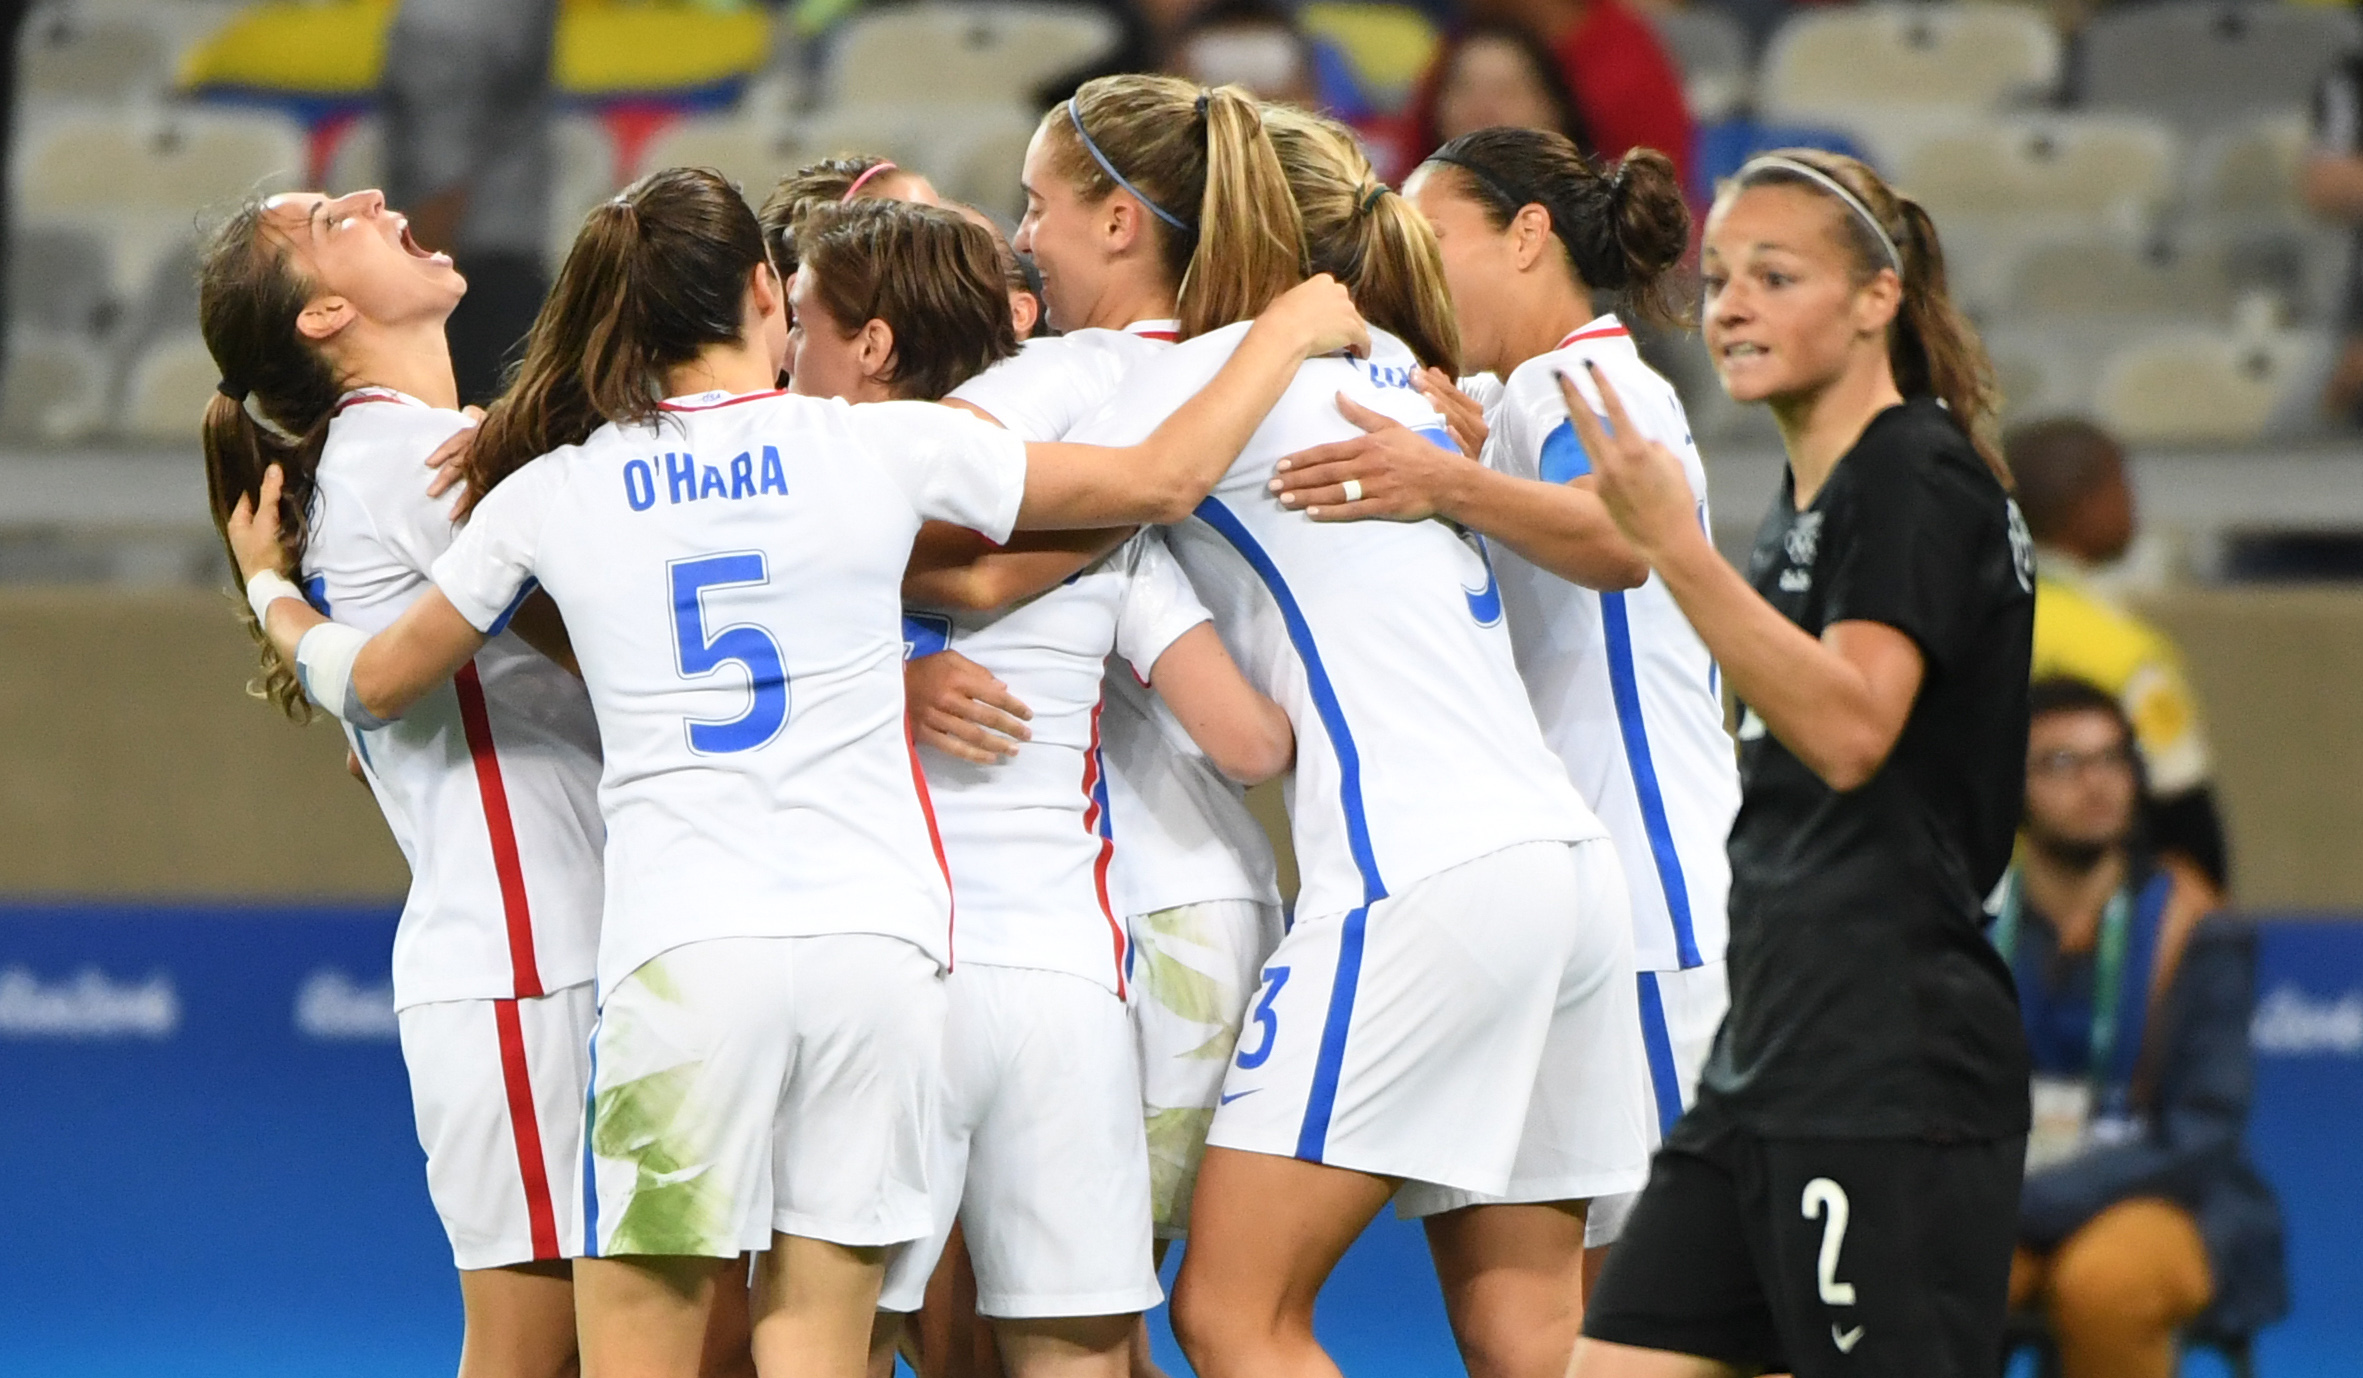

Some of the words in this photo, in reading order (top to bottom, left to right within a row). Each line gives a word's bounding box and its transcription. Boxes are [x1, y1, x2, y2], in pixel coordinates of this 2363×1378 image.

[623, 445, 789, 512] O'HARA
[666, 549, 792, 758] 5
[1236, 966, 1291, 1070] 3
[1802, 1177, 1857, 1306] 2
